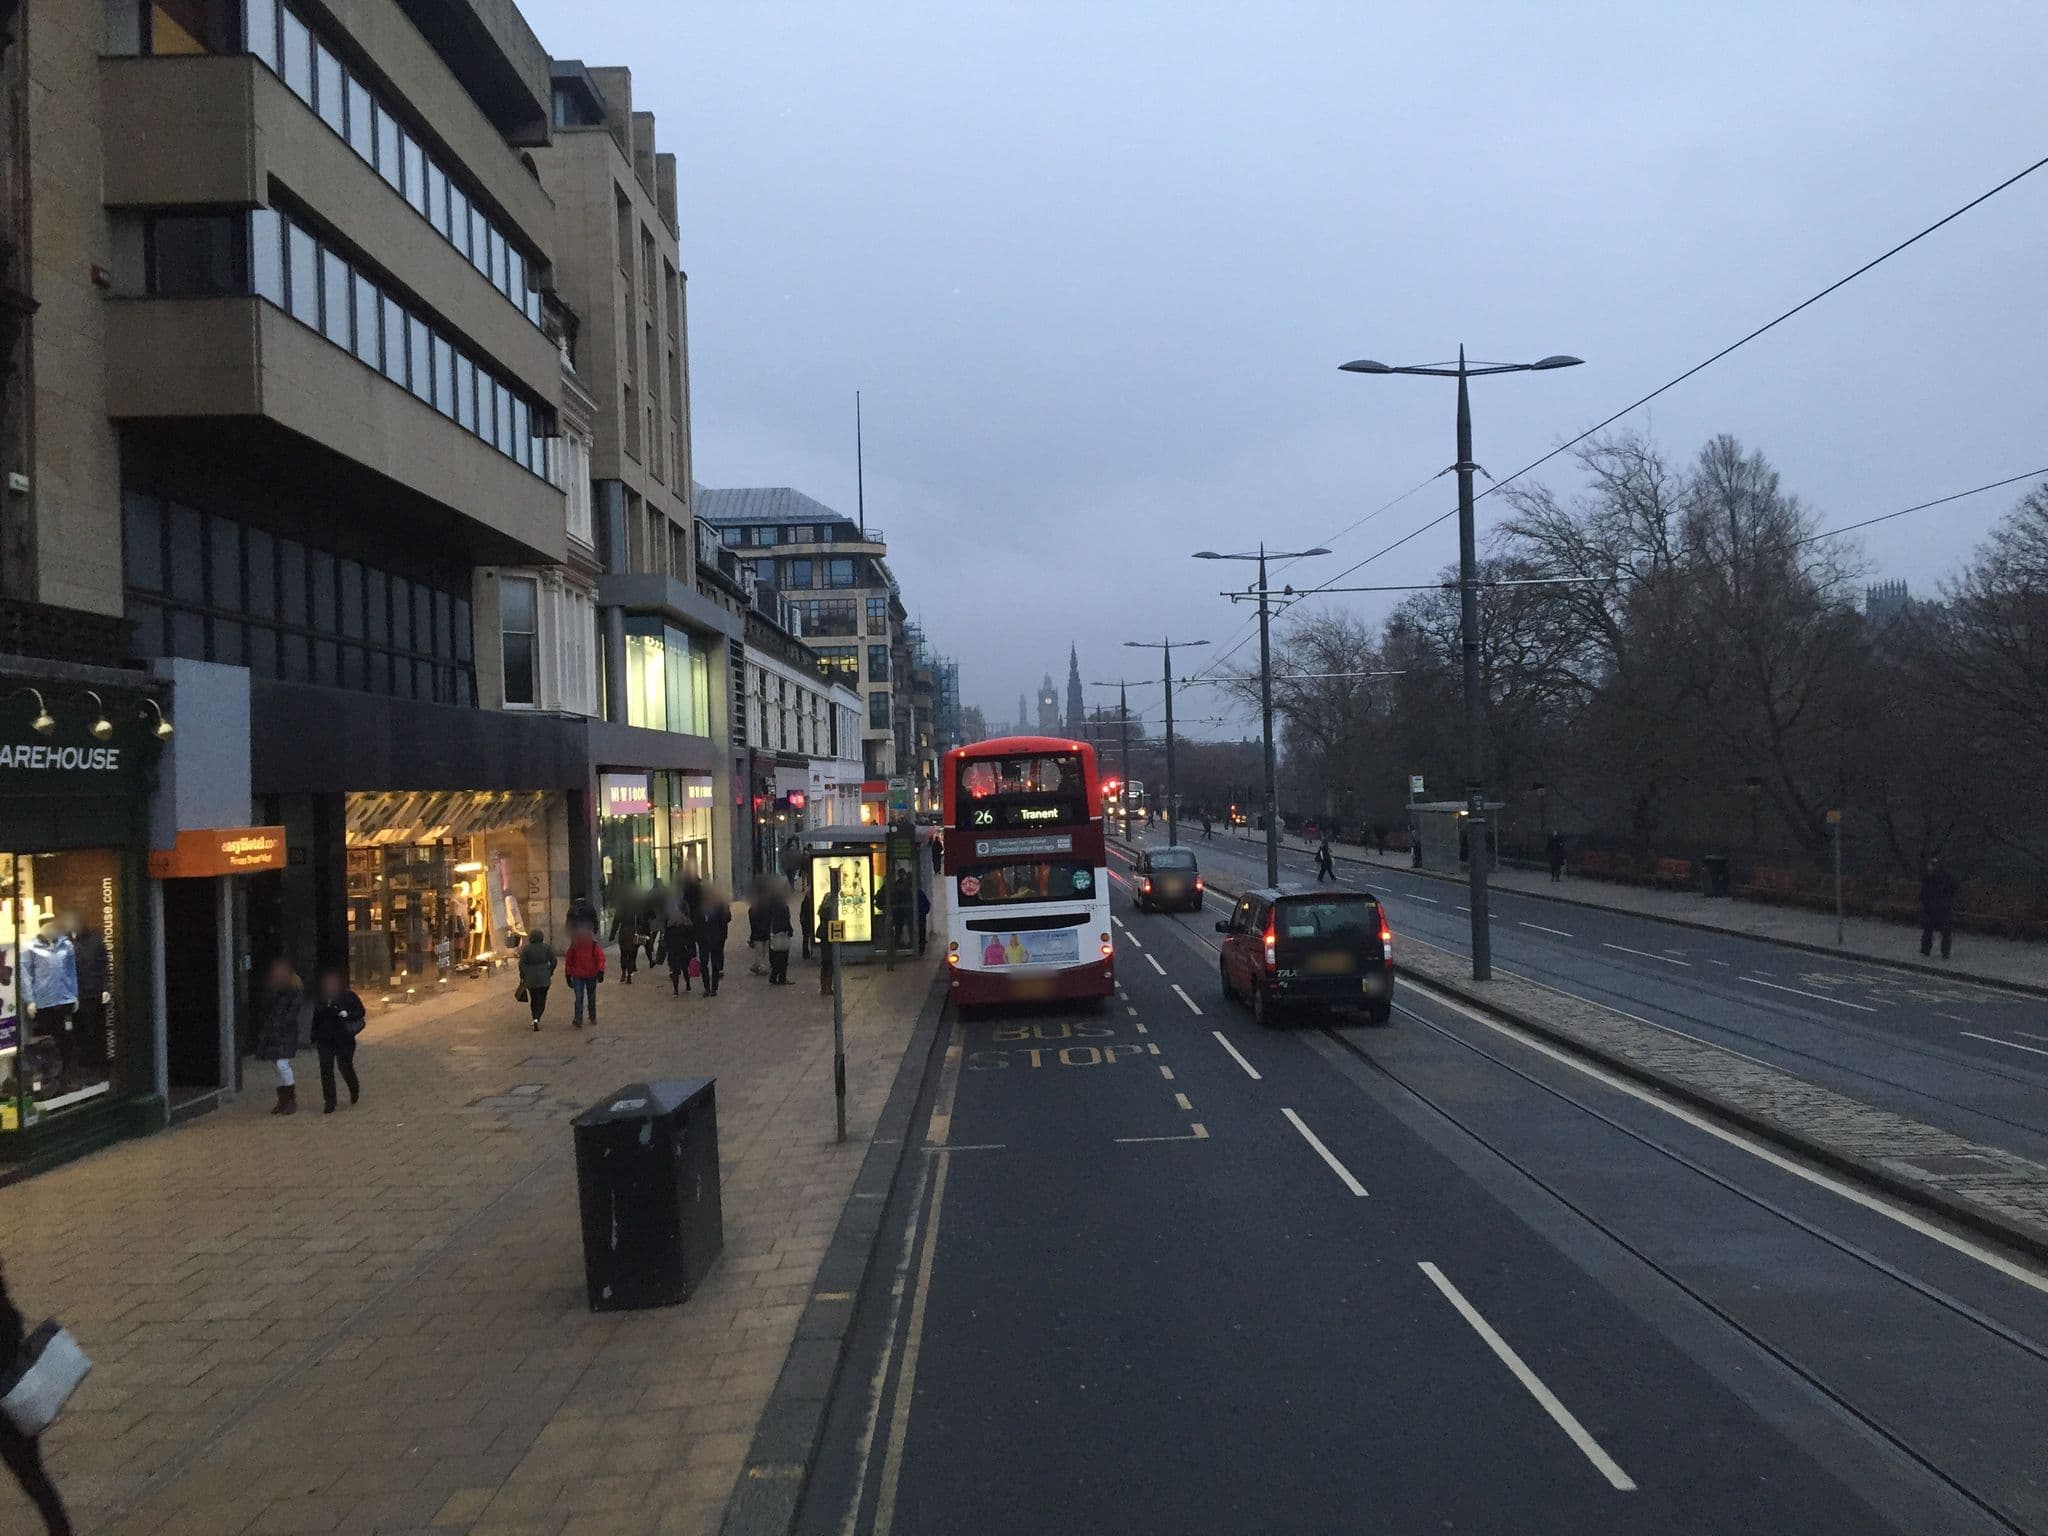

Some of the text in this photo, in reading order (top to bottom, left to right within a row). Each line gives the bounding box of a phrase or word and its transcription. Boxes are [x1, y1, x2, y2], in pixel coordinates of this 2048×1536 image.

[0, 744, 120, 770] AREHOUSE
[974, 807, 1059, 825] 26 Tranent
[1276, 969, 1302, 978] TAX
[993, 1021, 1116, 1040] BUS
[968, 1043, 1143, 1070] STOP
